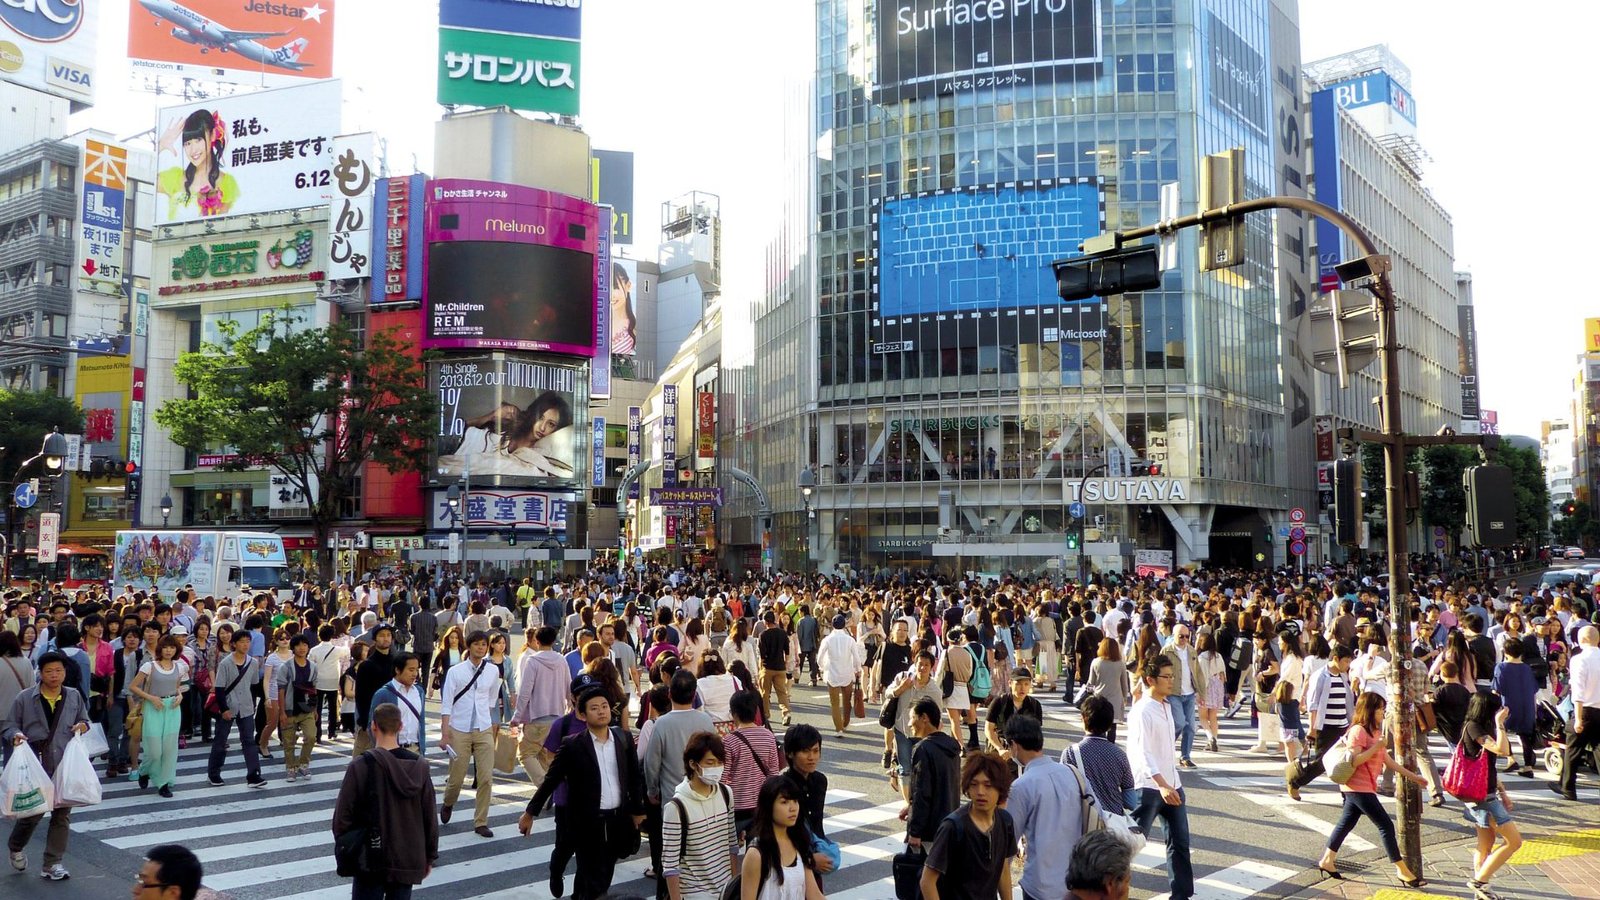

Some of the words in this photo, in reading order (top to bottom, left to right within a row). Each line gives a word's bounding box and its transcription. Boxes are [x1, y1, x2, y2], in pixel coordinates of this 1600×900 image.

[244, 0, 305, 19] Jetstar
[897, 0, 1004, 35] Surface
[53, 64, 91, 87] VISA
[444, 51, 575, 89] サロンパス
[232, 117, 269, 138] 私も、
[232, 136, 333, 167] 前島亜美です。
[295, 170, 330, 189] 6.12
[475, 189, 508, 198] チャンネル
[330, 148, 371, 274] もんじゃ
[83, 227, 120, 245] 夜11時
[386, 181, 404, 293] 三千里薬品
[90, 244, 113, 257] まで
[99, 263, 120, 278] 地下
[434, 302, 484, 312] Mr.Children
[1060, 328, 1107, 339] Microsoft
[440, 364, 453, 375] 4th
[454, 363, 478, 374] Single
[440, 373, 483, 388] 2013.6.12
[485, 372, 507, 385] OUT
[439, 388, 463, 436] 1%
[890, 415, 1001, 433] STARBUCKS
[1068, 481, 1187, 501] TSUTAYA
[376, 538, 420, 549] 三千里薬品
